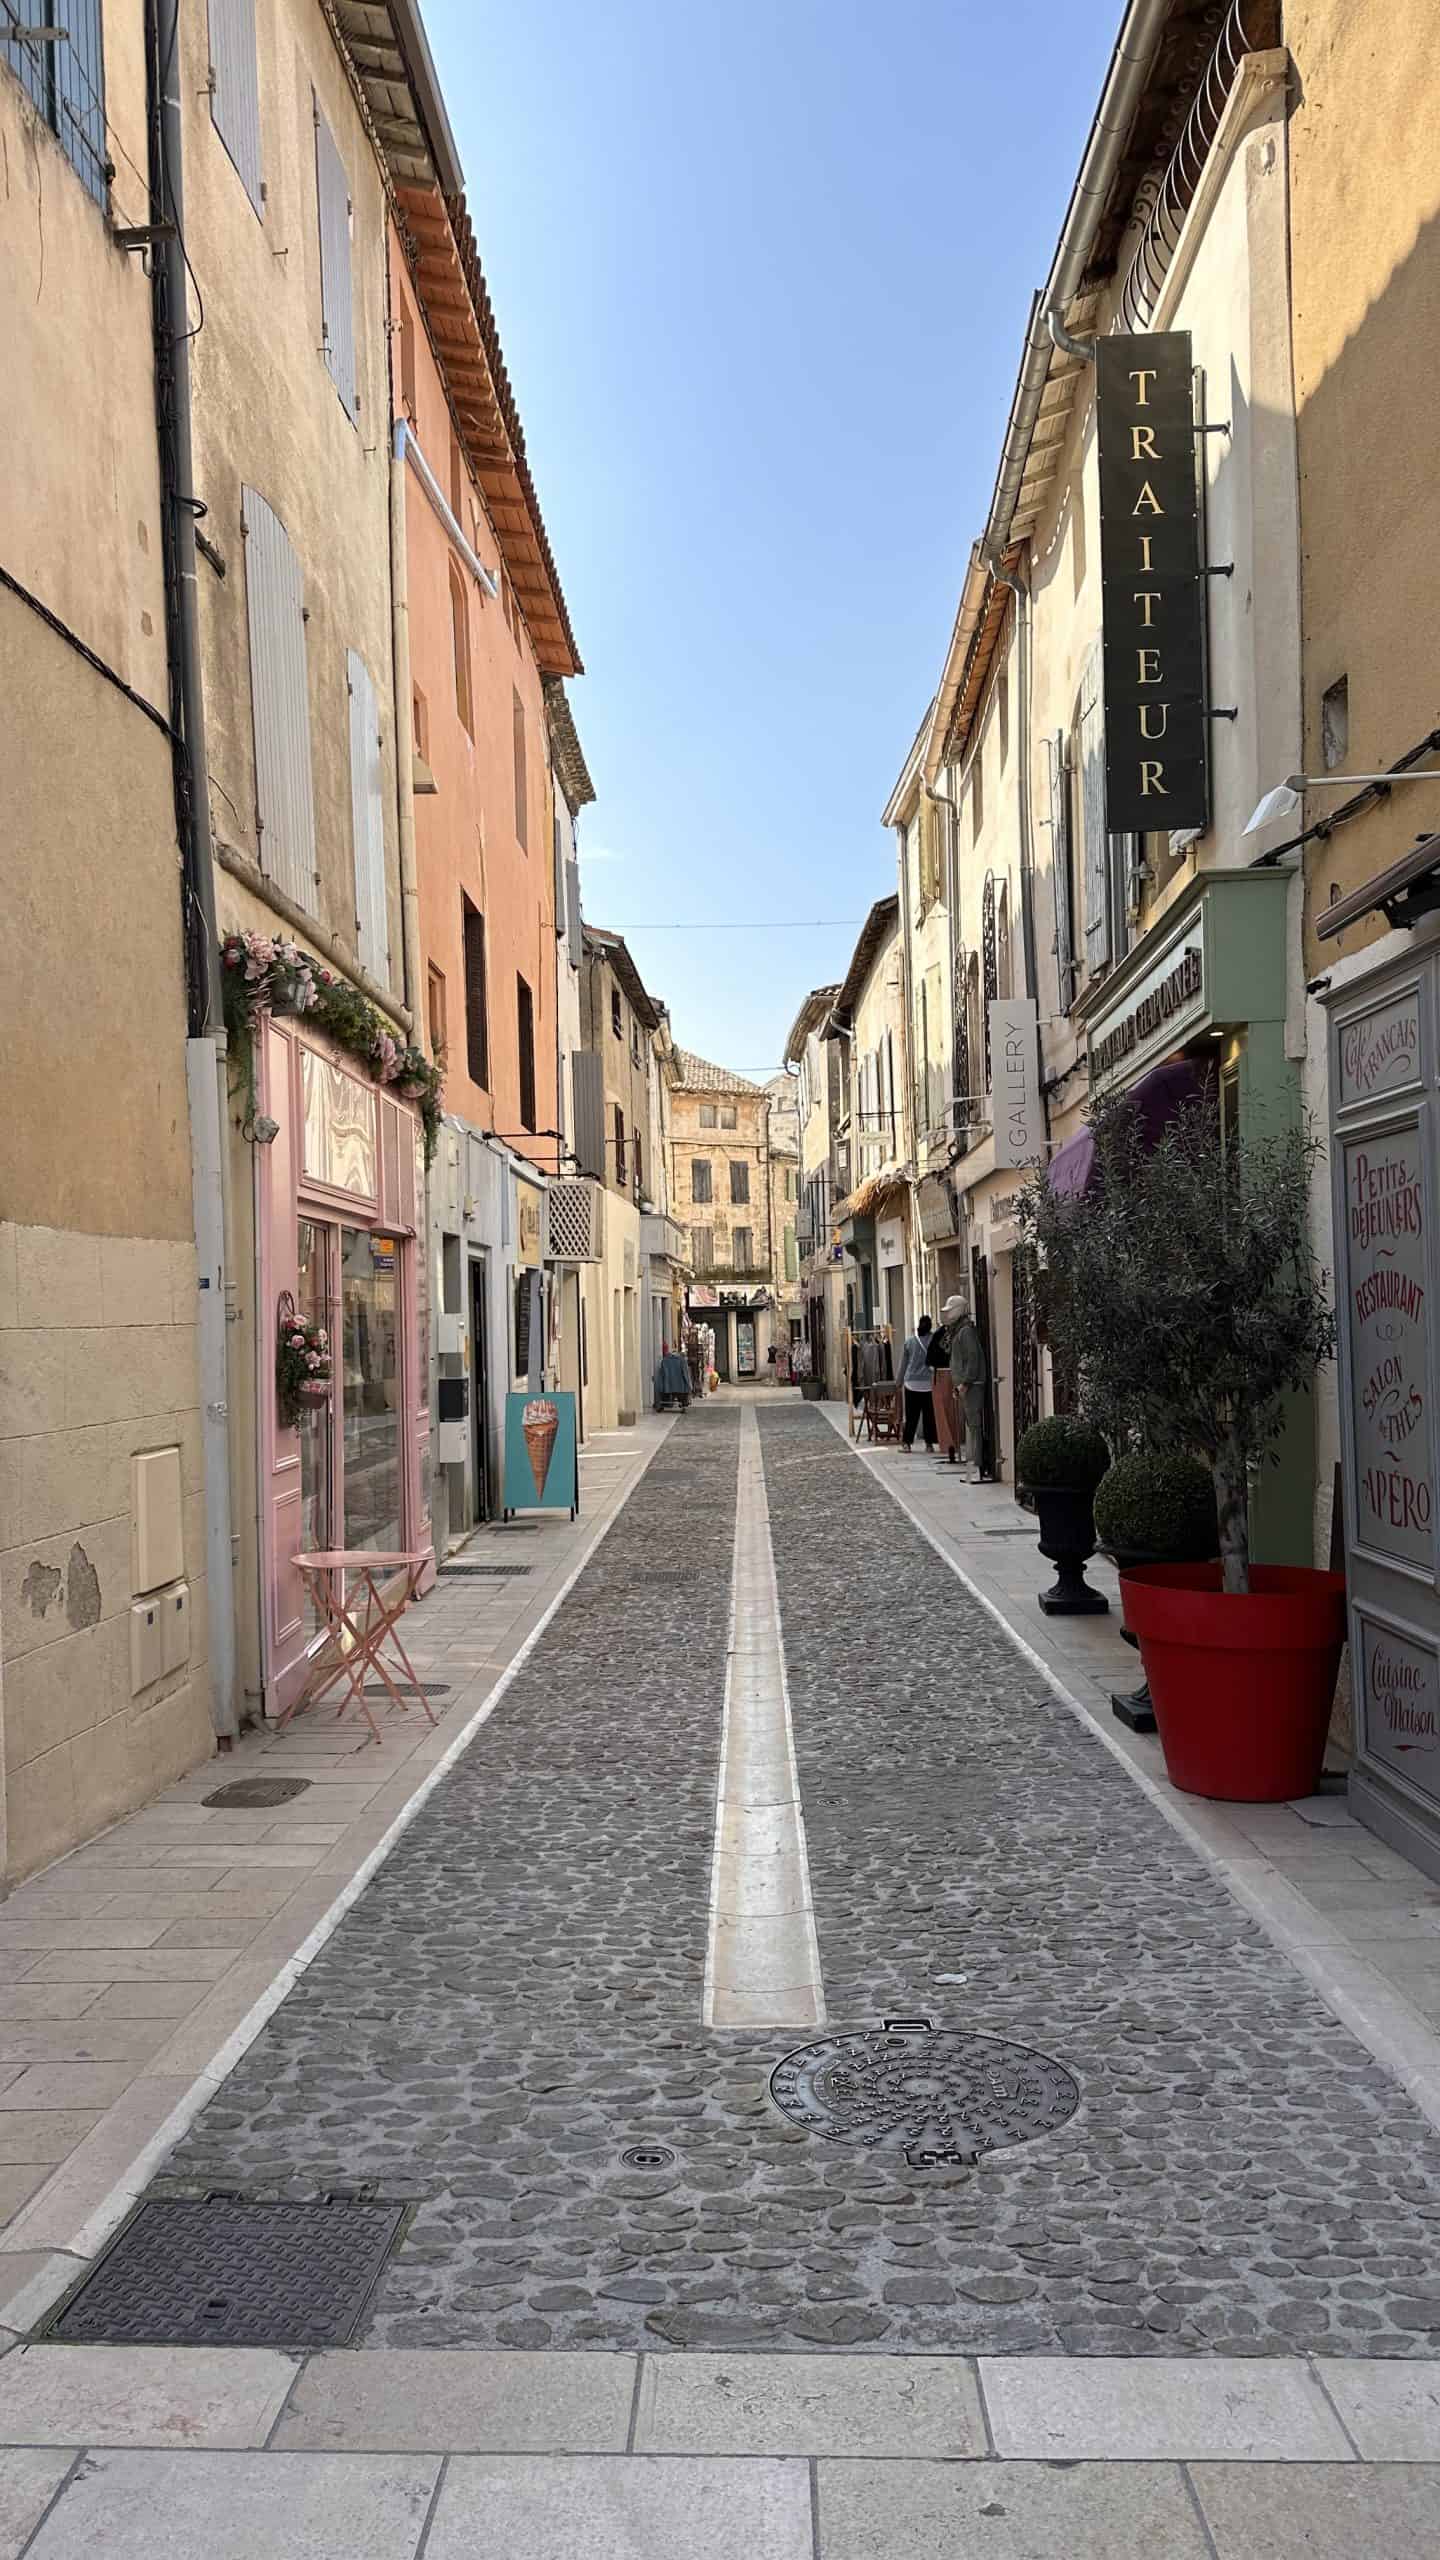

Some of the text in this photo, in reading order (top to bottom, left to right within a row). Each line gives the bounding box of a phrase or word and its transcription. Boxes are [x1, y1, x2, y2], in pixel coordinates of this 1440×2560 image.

[1128, 369, 1169, 797] TRAITEUR
[1005, 1021, 1028, 1147] GALLERY
[1355, 1270, 1425, 1325] RESTAURANT
[1362, 1356, 1403, 1421] SALON
